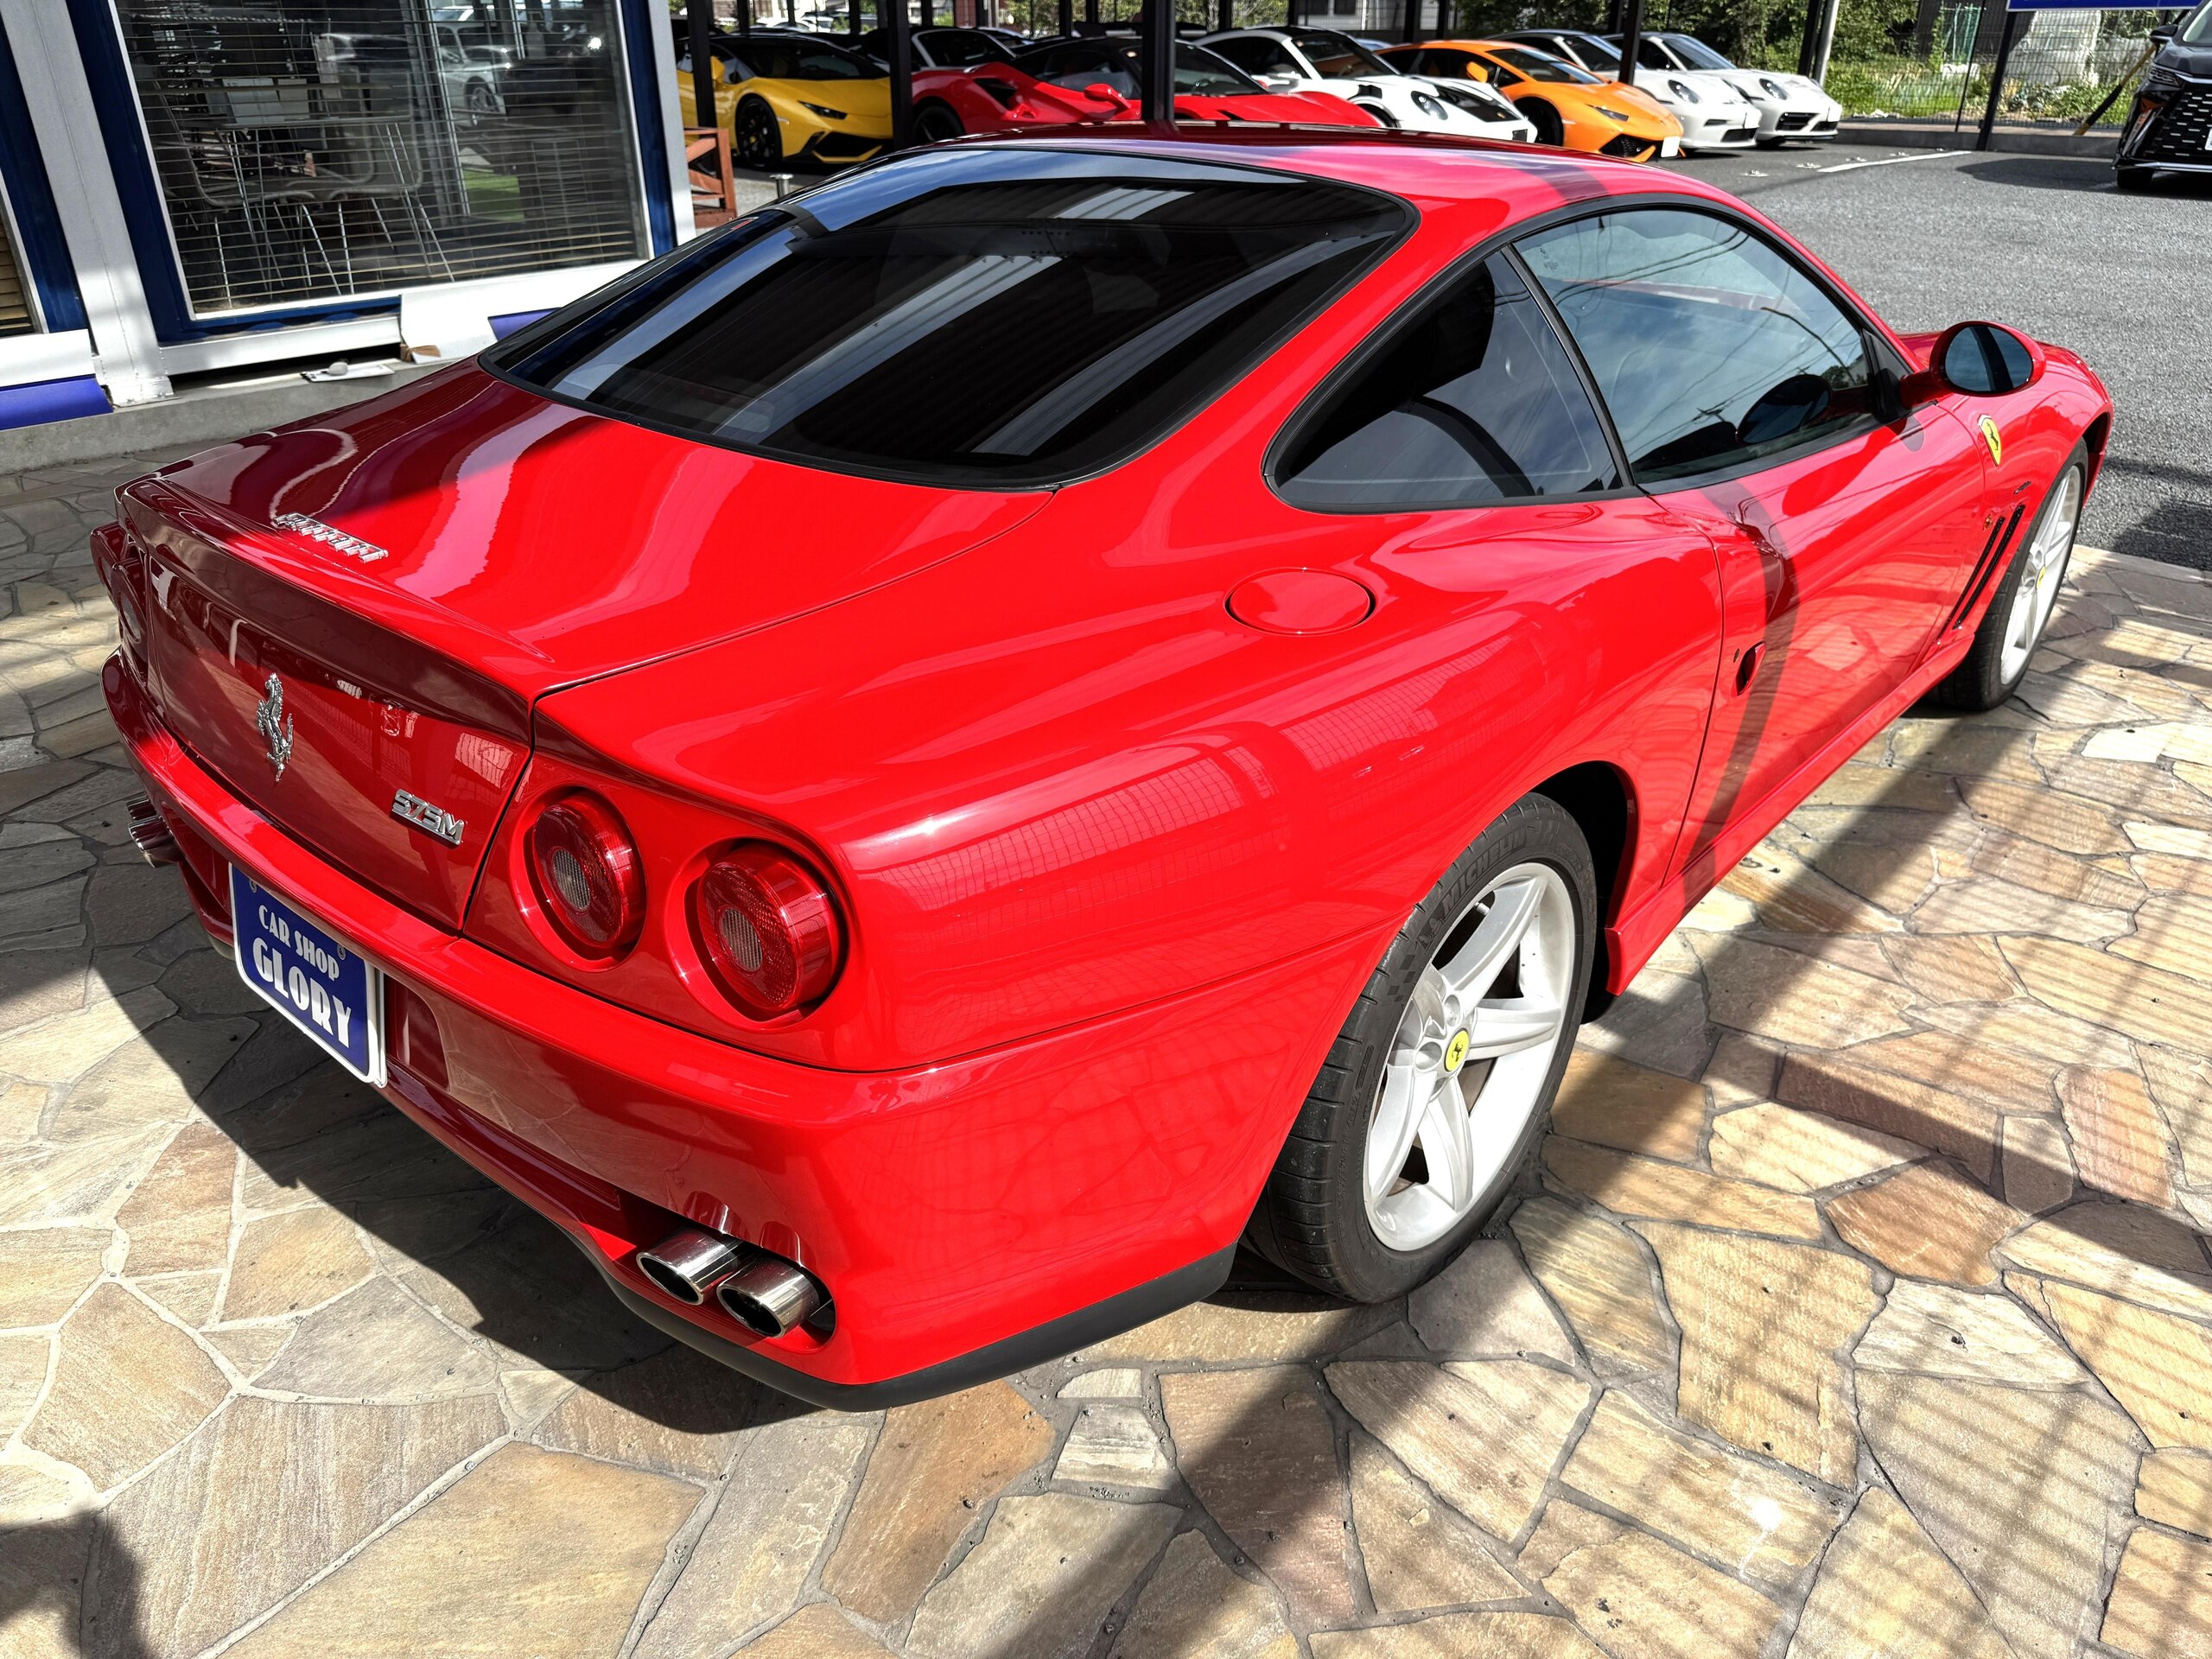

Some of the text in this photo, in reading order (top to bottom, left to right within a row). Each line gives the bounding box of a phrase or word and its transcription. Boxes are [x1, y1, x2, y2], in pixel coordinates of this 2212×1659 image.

[391, 788, 465, 846] 575M
[1442, 829, 1526, 917] MICHELIN
[258, 905, 340, 982] CAR SHOP
[252, 937, 352, 1048] GLORY
